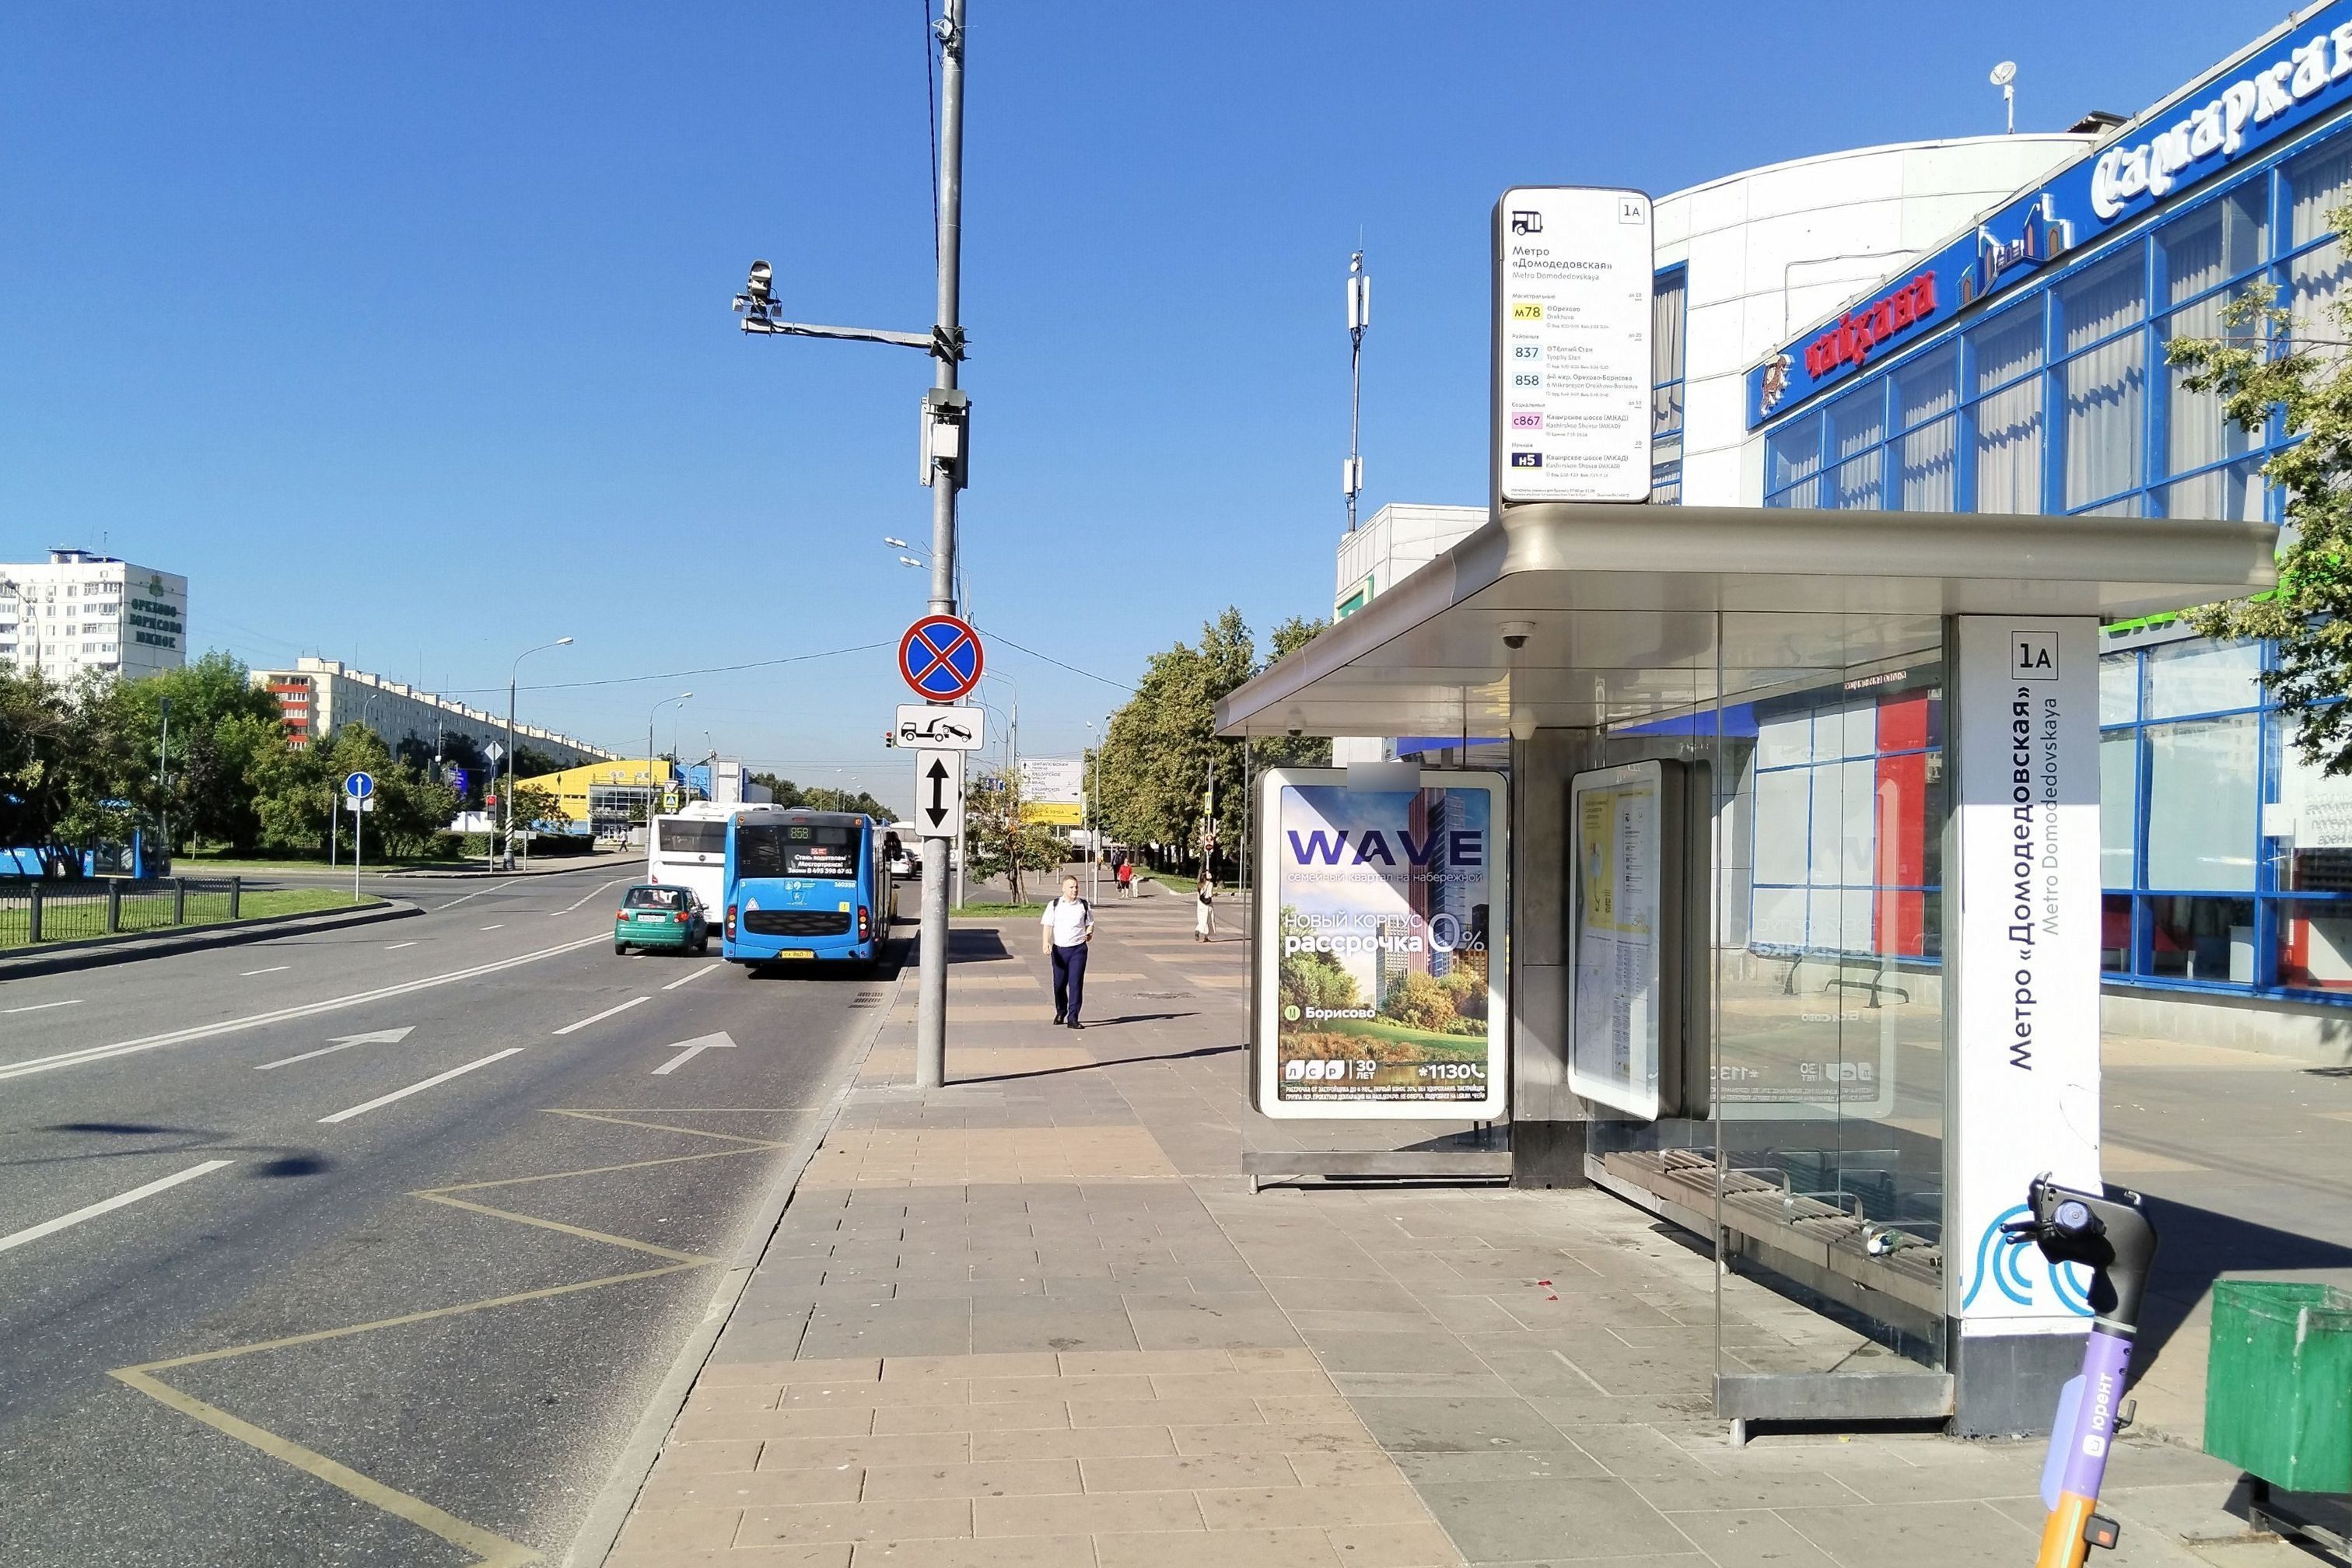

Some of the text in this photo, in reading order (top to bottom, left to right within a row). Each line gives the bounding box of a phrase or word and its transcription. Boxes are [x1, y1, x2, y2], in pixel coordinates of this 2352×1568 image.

[1512, 246, 1550, 257] Метро
[1512, 258, 1612, 270] «Домодедовская»
[1536, 272, 1600, 281] Domodedovskaya
[1514, 306, 1541, 317] м78
[1515, 347, 1538, 358] 837
[1515, 375, 1539, 386] 858
[1514, 416, 1540, 425] с867
[131, 598, 177, 618] ОРЕХОВО
[129, 614, 182, 634] БОРИСОВО
[2040, 697, 2060, 936] Metro Domodedovskaya
[790, 827, 809, 839] 858
[1286, 830, 1482, 866] WAVE
[1288, 870, 1345, 882] семейный
[1348, 873, 1393, 883] квартал
[1412, 870, 1484, 883] набережной
[2008, 685, 2037, 1072] Метро «Домодедовская»
[1286, 911, 1423, 929] НОВЫЙ КОРПУС
[1286, 935, 1423, 958] рассрочка
[1306, 1007, 1376, 1020] Борисово
[1356, 1060, 1376, 1072] 30
[2091, 1373, 2113, 1433] юрент
